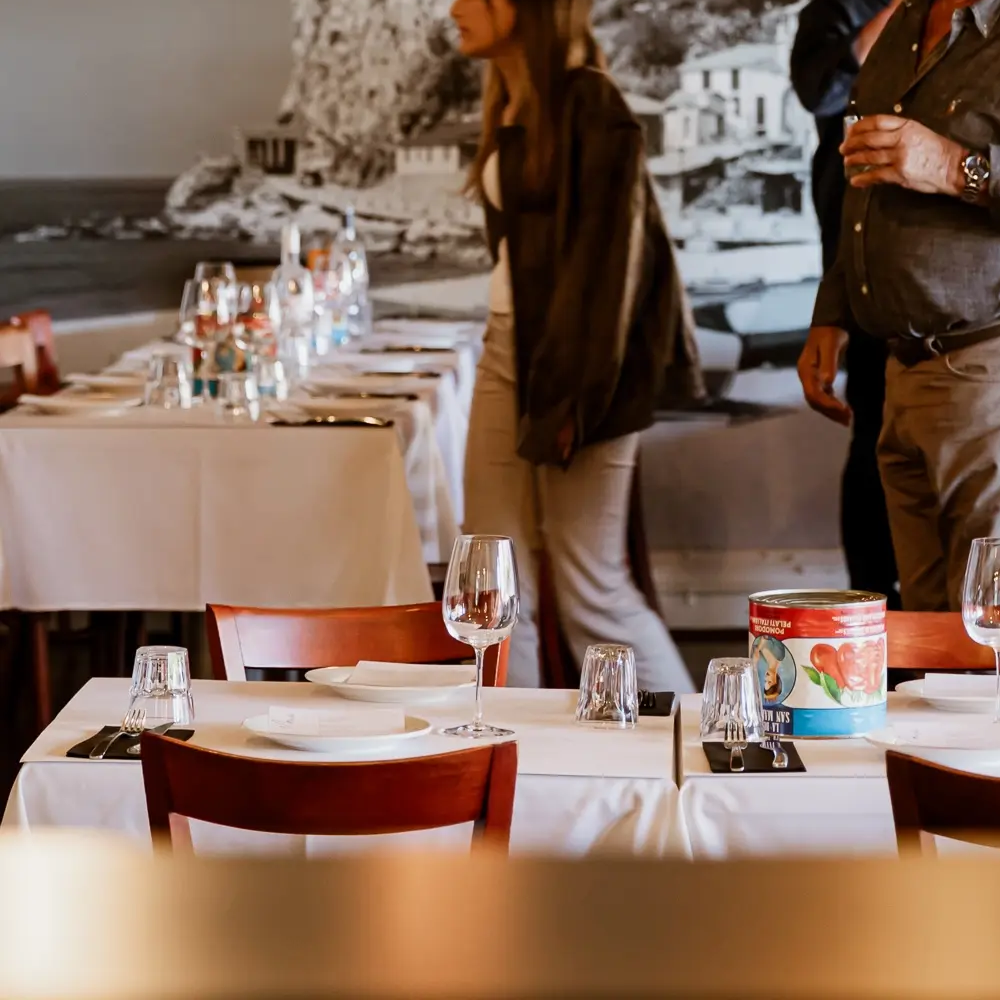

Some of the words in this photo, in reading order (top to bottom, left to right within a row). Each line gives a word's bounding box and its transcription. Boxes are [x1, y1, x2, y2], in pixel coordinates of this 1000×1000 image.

[770, 619, 792, 628] PELATI
[776, 711, 790, 724] SAN
[772, 722, 780, 733] LA
